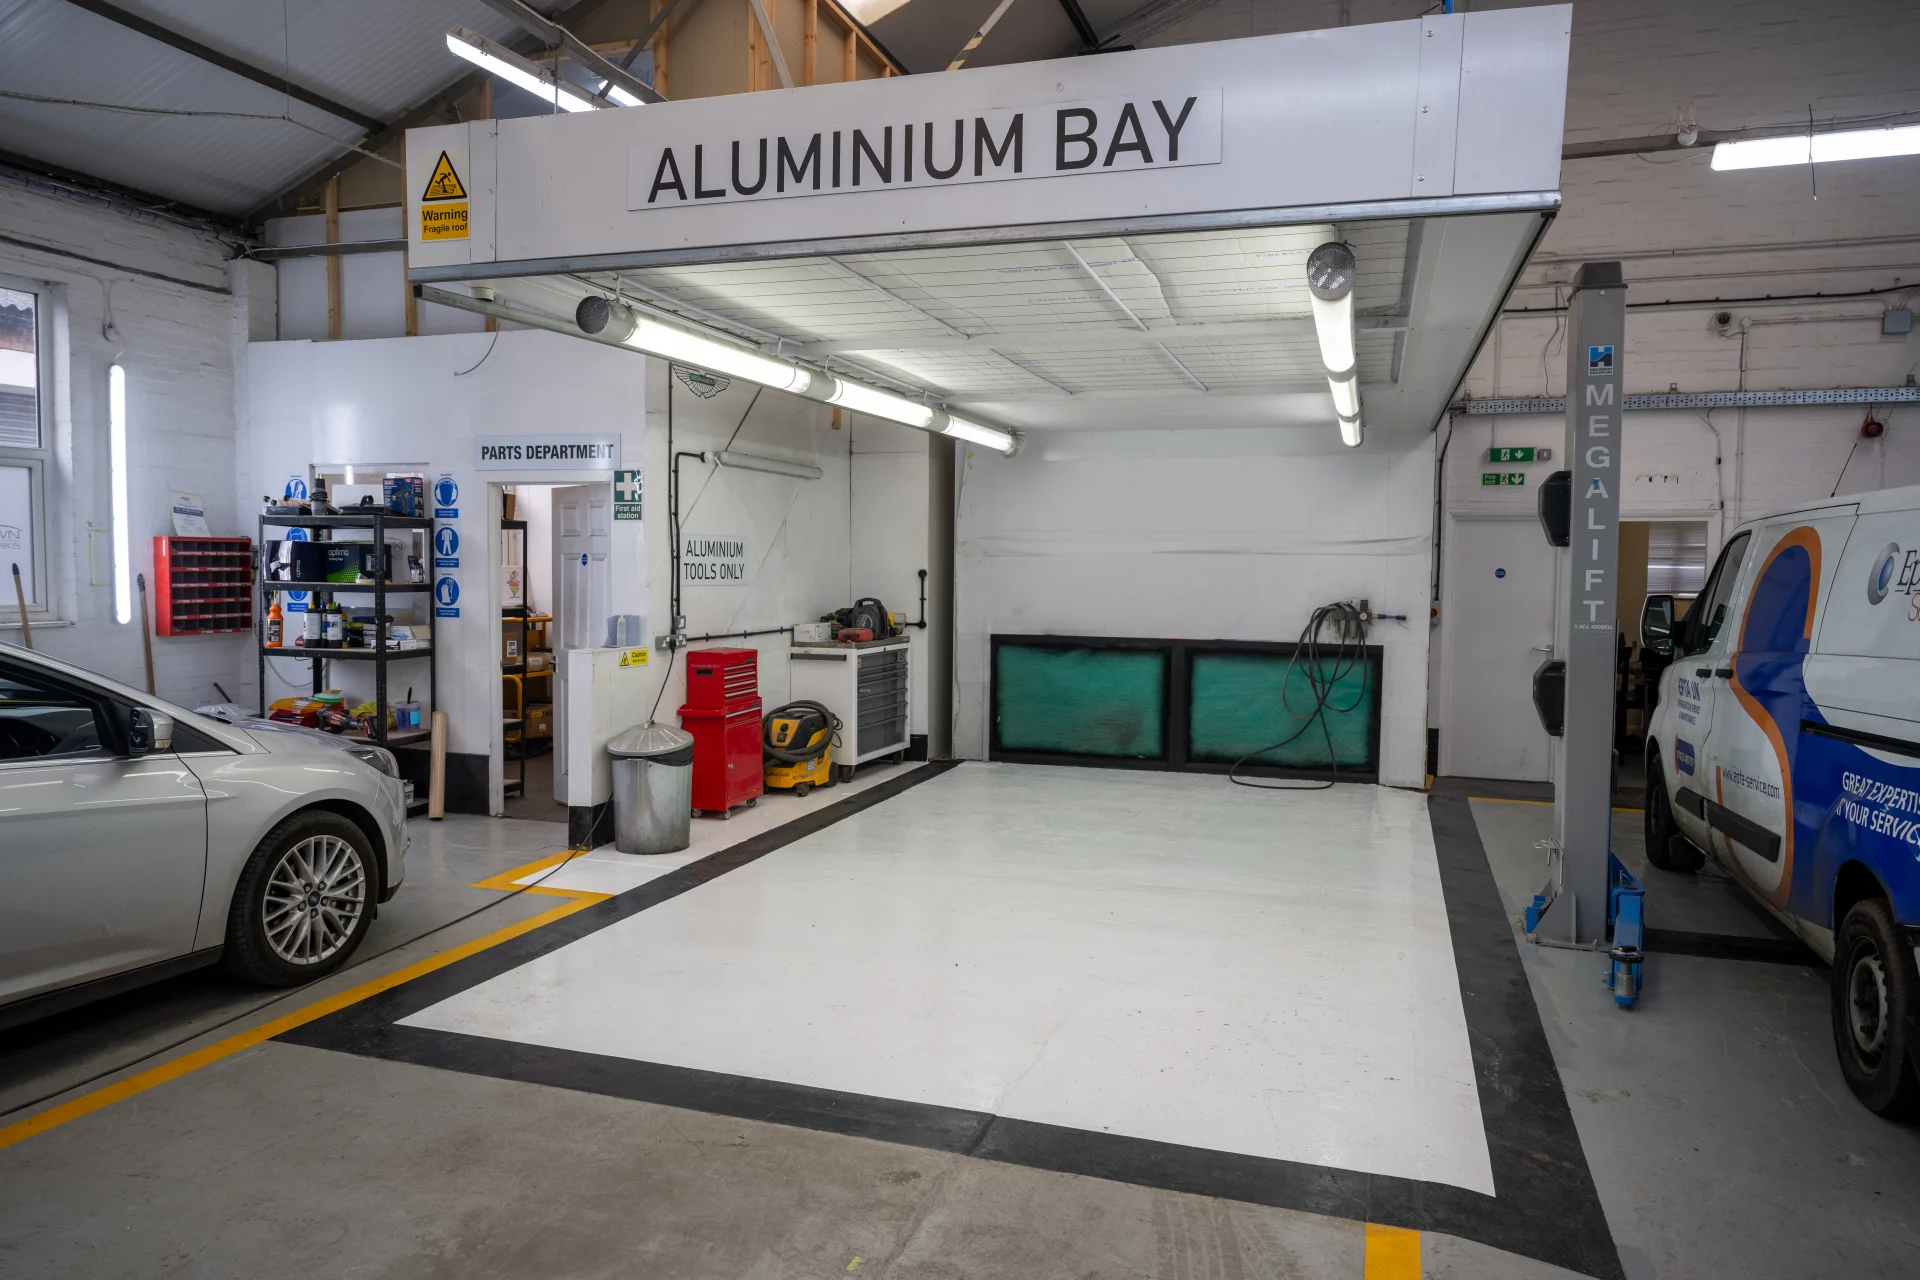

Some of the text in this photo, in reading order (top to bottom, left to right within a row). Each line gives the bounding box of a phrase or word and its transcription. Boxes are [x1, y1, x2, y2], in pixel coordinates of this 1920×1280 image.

[649, 97, 1197, 203] ALUMINIUM BAY
[422, 209, 468, 222] Warning
[424, 222, 468, 234] Fragile roof
[481, 444, 614, 460] PARTS DEPARTMENT
[631, 504, 641, 512] aid
[1583, 383, 1614, 622] MEGALIFT
[328, 548, 349, 558] optima
[686, 540, 743, 557] ALUMINIUM
[684, 563, 744, 580] TOOLS ONLY
[1722, 768, 1780, 800] www.epta-service.com
[1842, 771, 1873, 798] GREAT
[1844, 799, 1870, 828] YOUR
[1869, 810, 1920, 848] SERVIC
